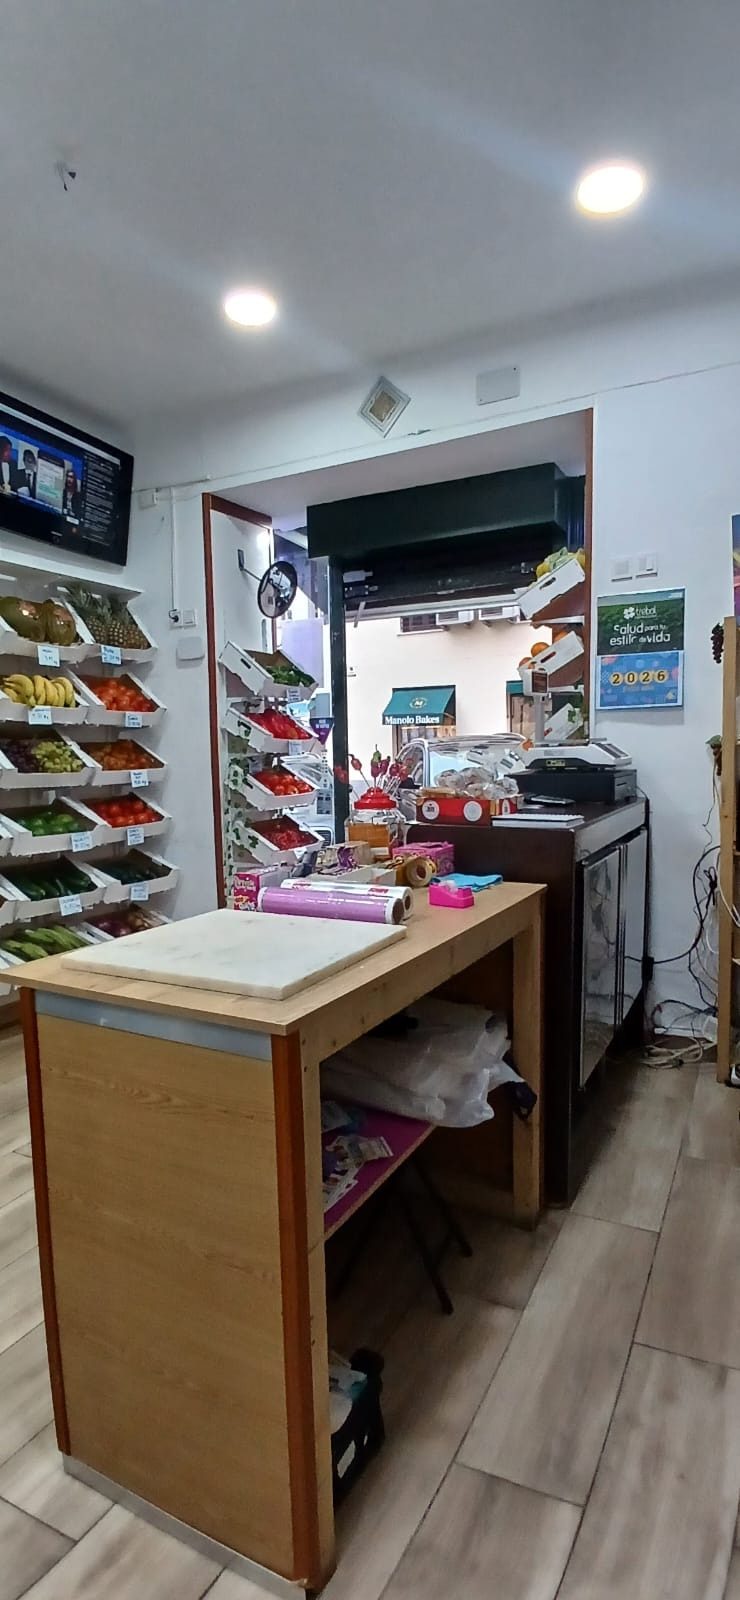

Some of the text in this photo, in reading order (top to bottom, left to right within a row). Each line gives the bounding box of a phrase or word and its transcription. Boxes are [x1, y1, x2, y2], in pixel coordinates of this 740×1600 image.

[646, 630, 671, 643] vida
[611, 669, 666, 685] 2026
[384, 715, 440, 725] Manolo Bakes
